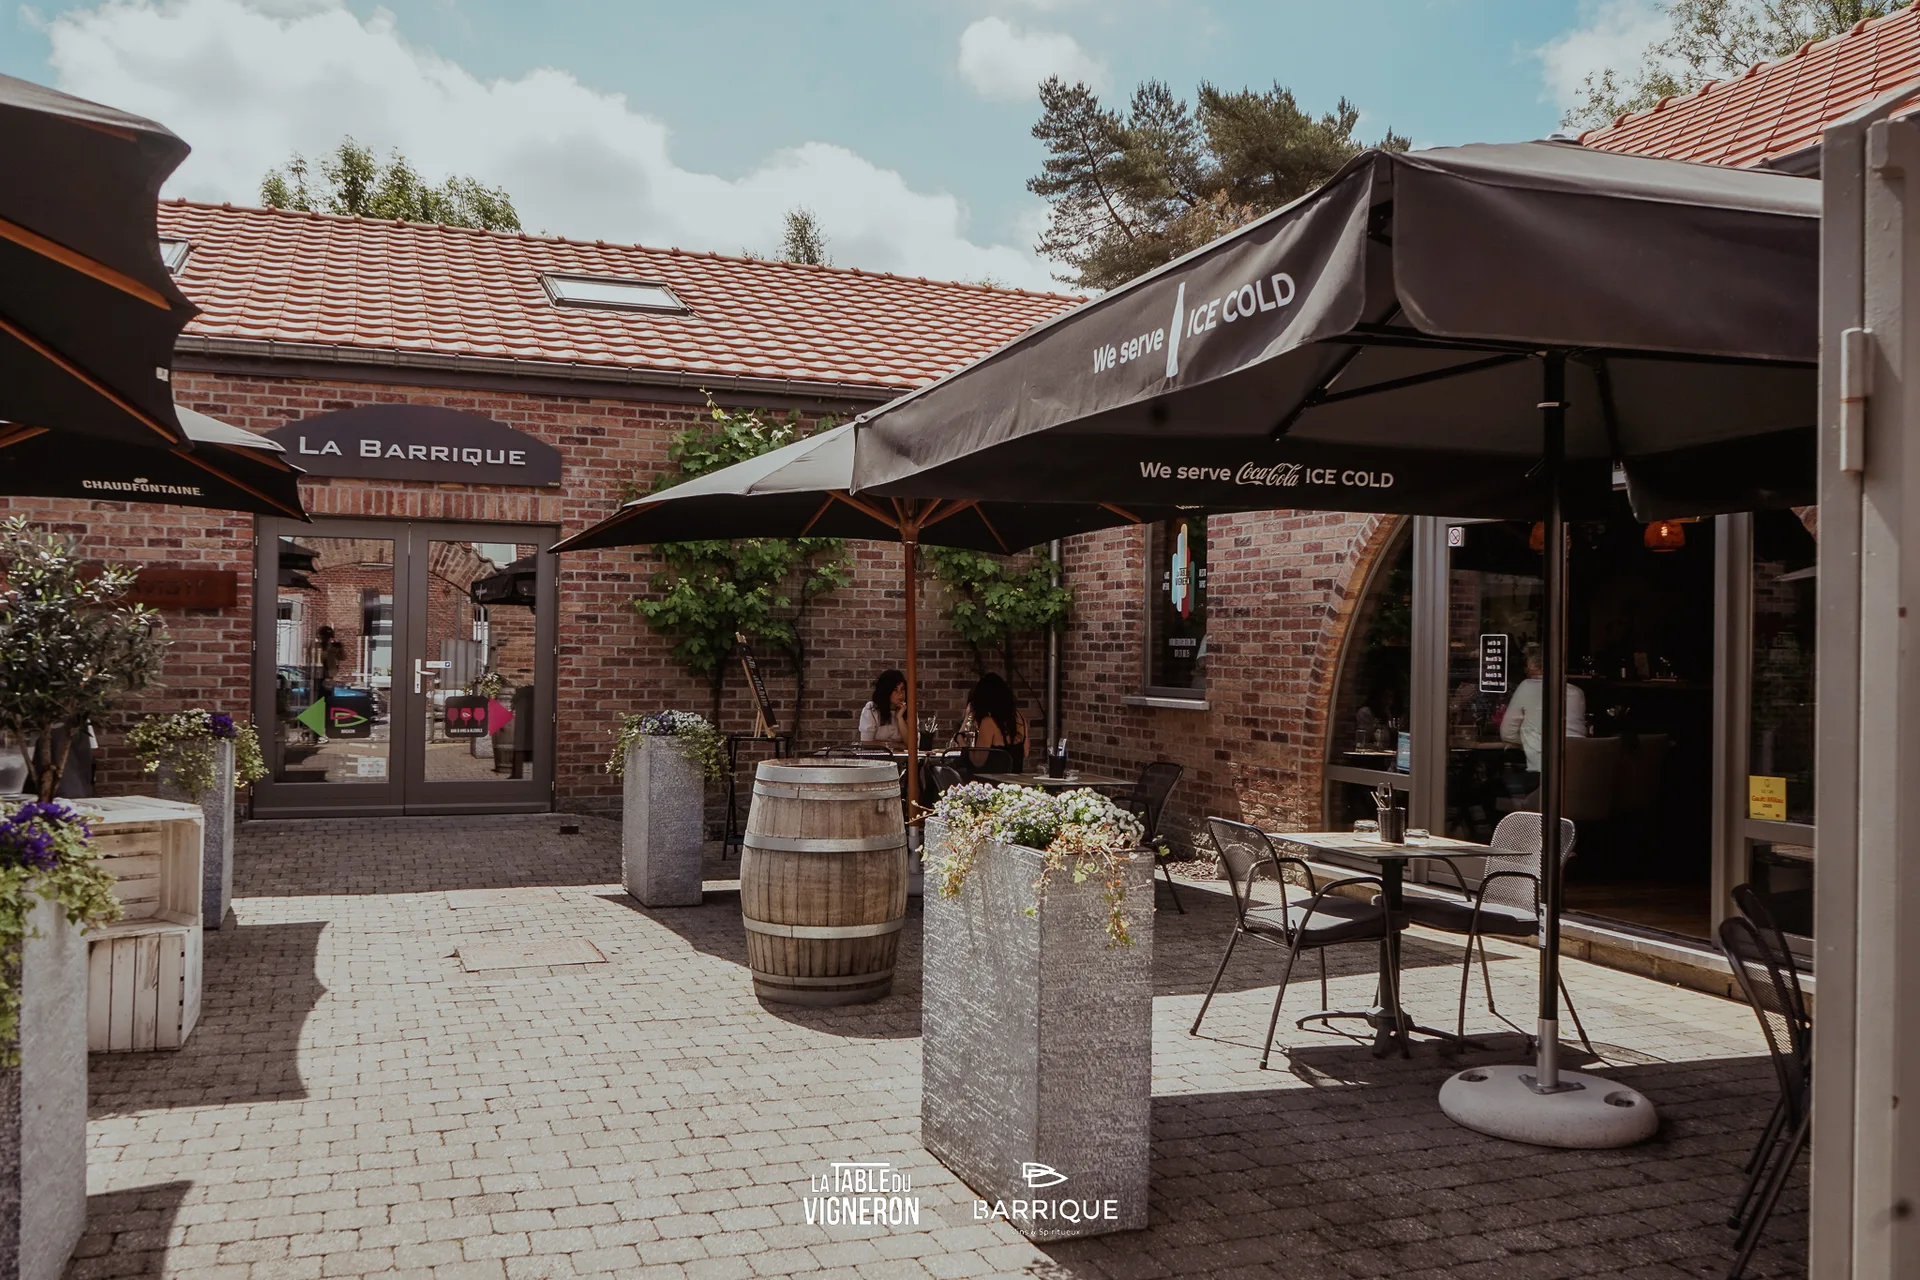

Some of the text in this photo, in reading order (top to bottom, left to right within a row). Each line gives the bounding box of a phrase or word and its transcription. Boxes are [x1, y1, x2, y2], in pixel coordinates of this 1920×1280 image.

[1093, 272, 1296, 374] We serve ICE COLD
[299, 436, 526, 466] LA BARRIQUE
[82, 480, 202, 496] CHAUDFONTAINE
[1139, 461, 1394, 488] We serve Coca-Cola ICE COLD
